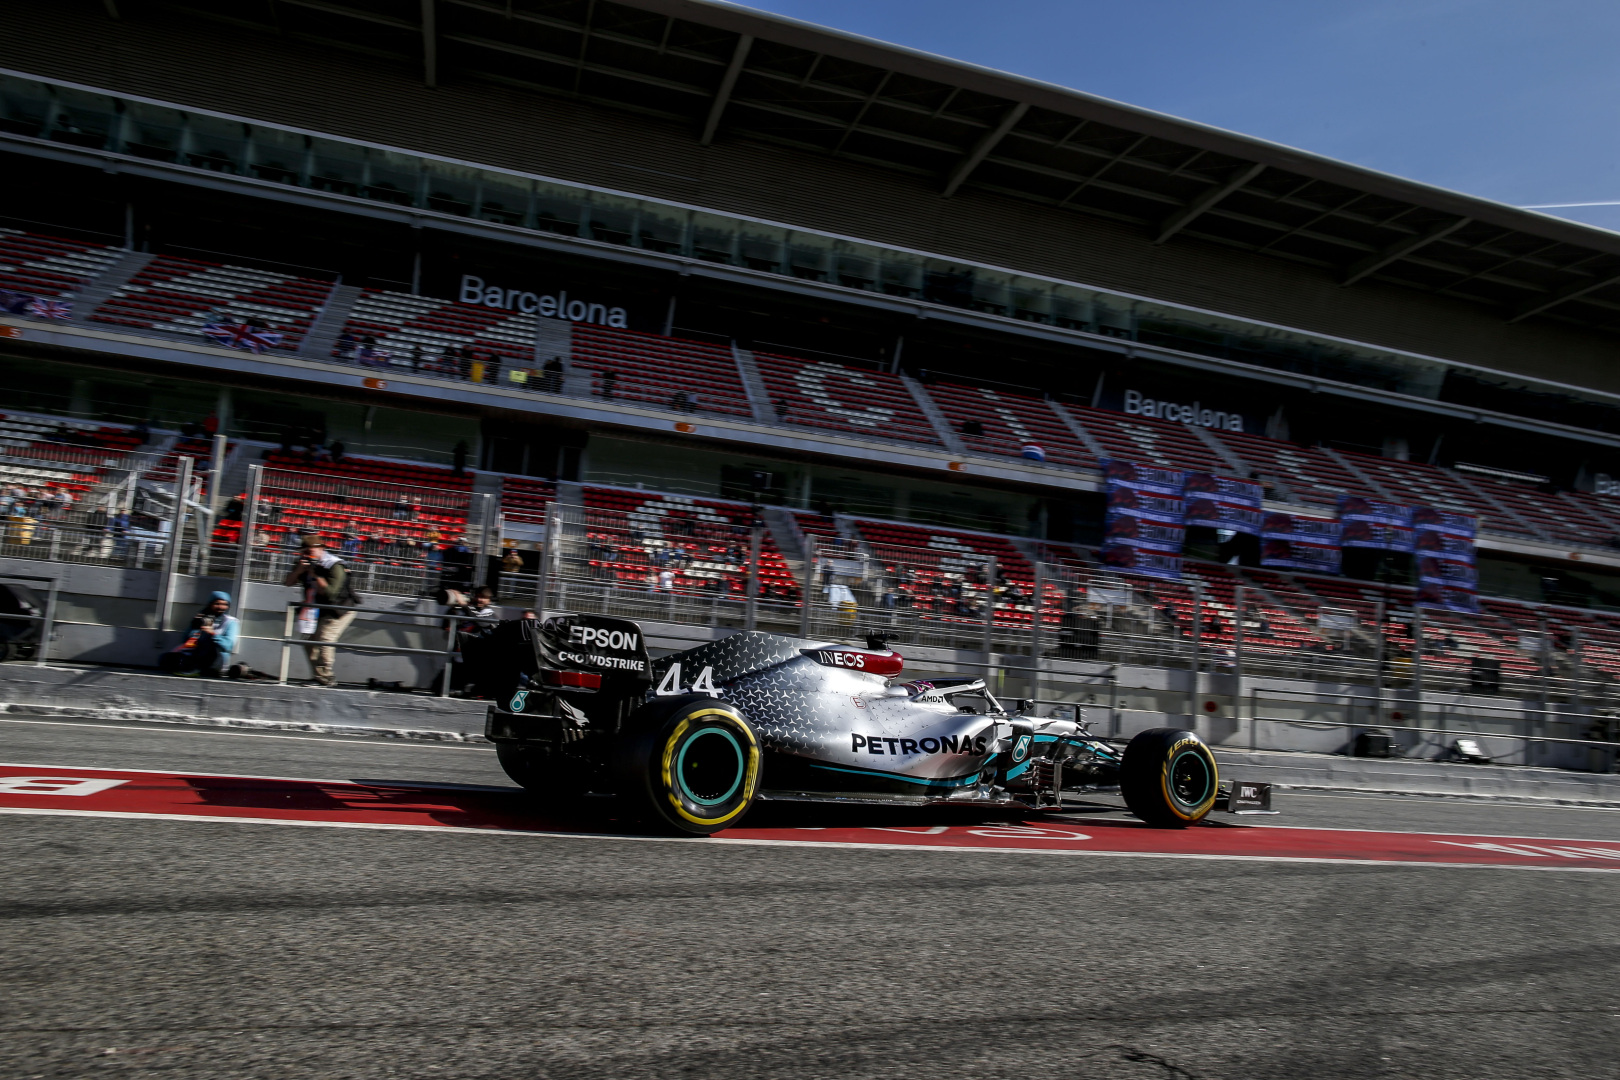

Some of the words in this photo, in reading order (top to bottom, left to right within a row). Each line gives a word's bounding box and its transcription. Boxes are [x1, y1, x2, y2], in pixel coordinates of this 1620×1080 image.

[459, 274, 628, 329] Barcelona
[1124, 389, 1244, 432] Barcelona
[568, 625, 638, 651] EPSON
[558, 651, 645, 671] CROWDSTRIKE
[818, 651, 865, 668] INEOS
[656, 662, 724, 698] 44
[921, 695, 938, 703] AMD
[851, 733, 987, 757] PETRONAS
[1240, 786, 1257, 798] IWC
